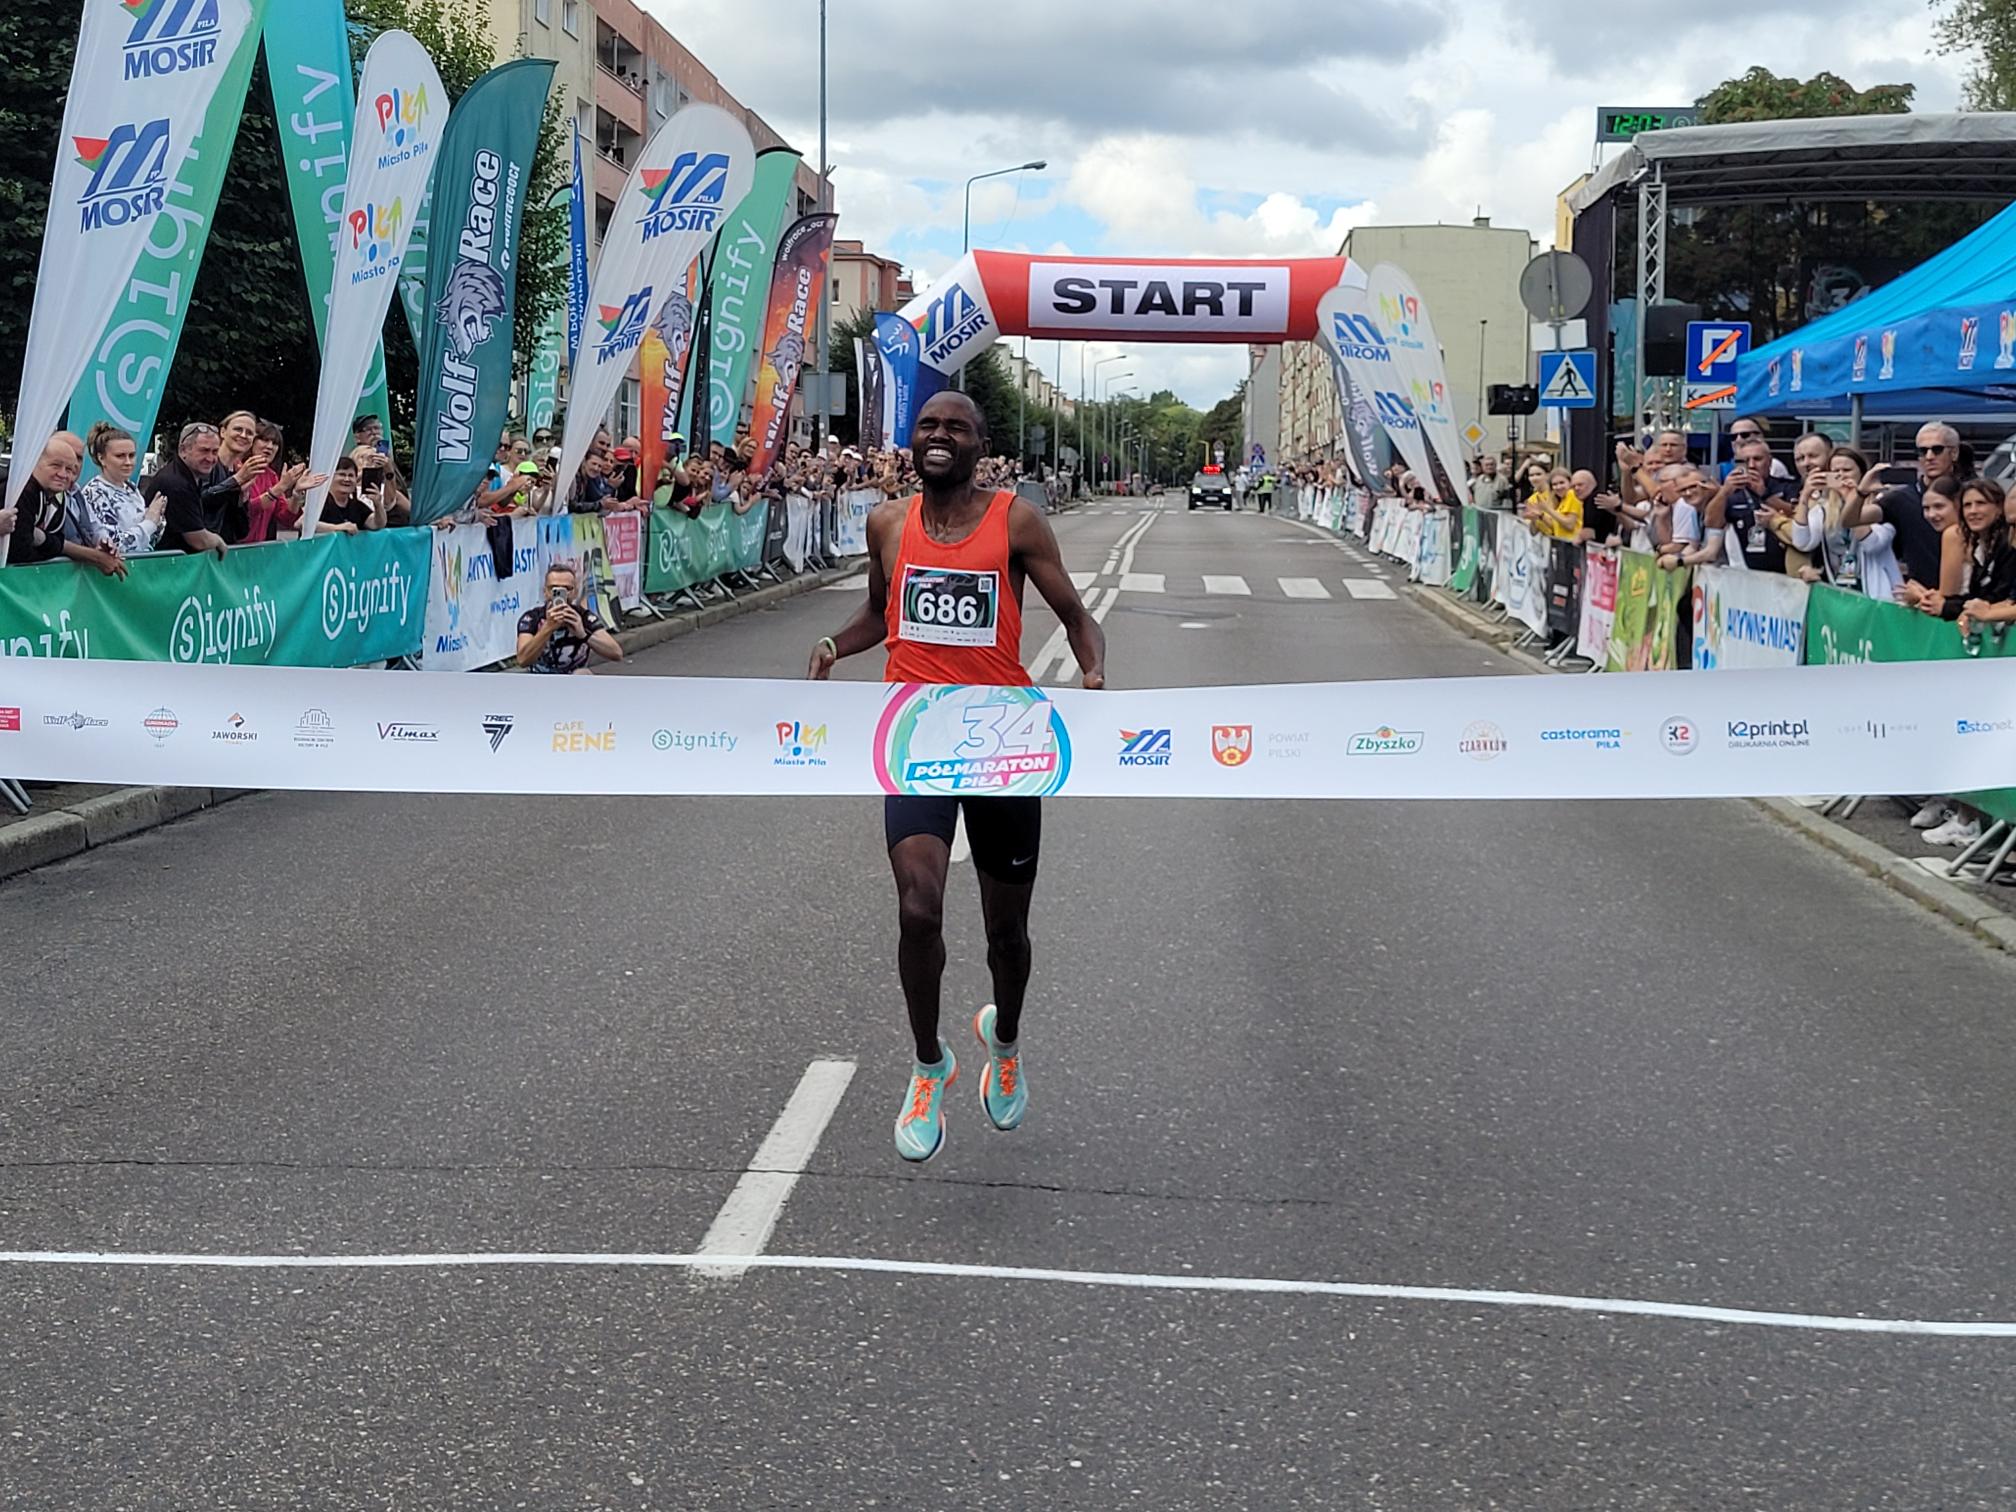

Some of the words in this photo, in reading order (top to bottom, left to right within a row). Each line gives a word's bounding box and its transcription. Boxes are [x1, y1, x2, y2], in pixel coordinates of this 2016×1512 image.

[123, 39, 217, 81] MOSiR
[459, 149, 501, 263] Race
[641, 208, 717, 244] MOSiR
[352, 266, 386, 285] Miasto
[787, 266, 812, 335] Race
[1052, 277, 1266, 317] START
[929, 313, 990, 365] MOSiR
[436, 350, 478, 464] Wolf
[322, 561, 412, 640] signify
[917, 592, 977, 625] 686
[211, 731, 257, 741] JAWORSKI
[377, 722, 441, 740] Vilmax
[554, 722, 584, 731] CAFE
[953, 700, 1054, 760] 34
[1540, 728, 1621, 740] castorama
[1268, 732, 1310, 743] POWIAT
[1356, 736, 1415, 753] Zbyszko
[1779, 739, 1810, 747] ONLINE
[774, 757, 805, 766] Miasto
[914, 756, 1050, 778] PÓŁMARATON
[1118, 754, 1170, 766] MOSiR
[958, 775, 1003, 788] PIŁA
